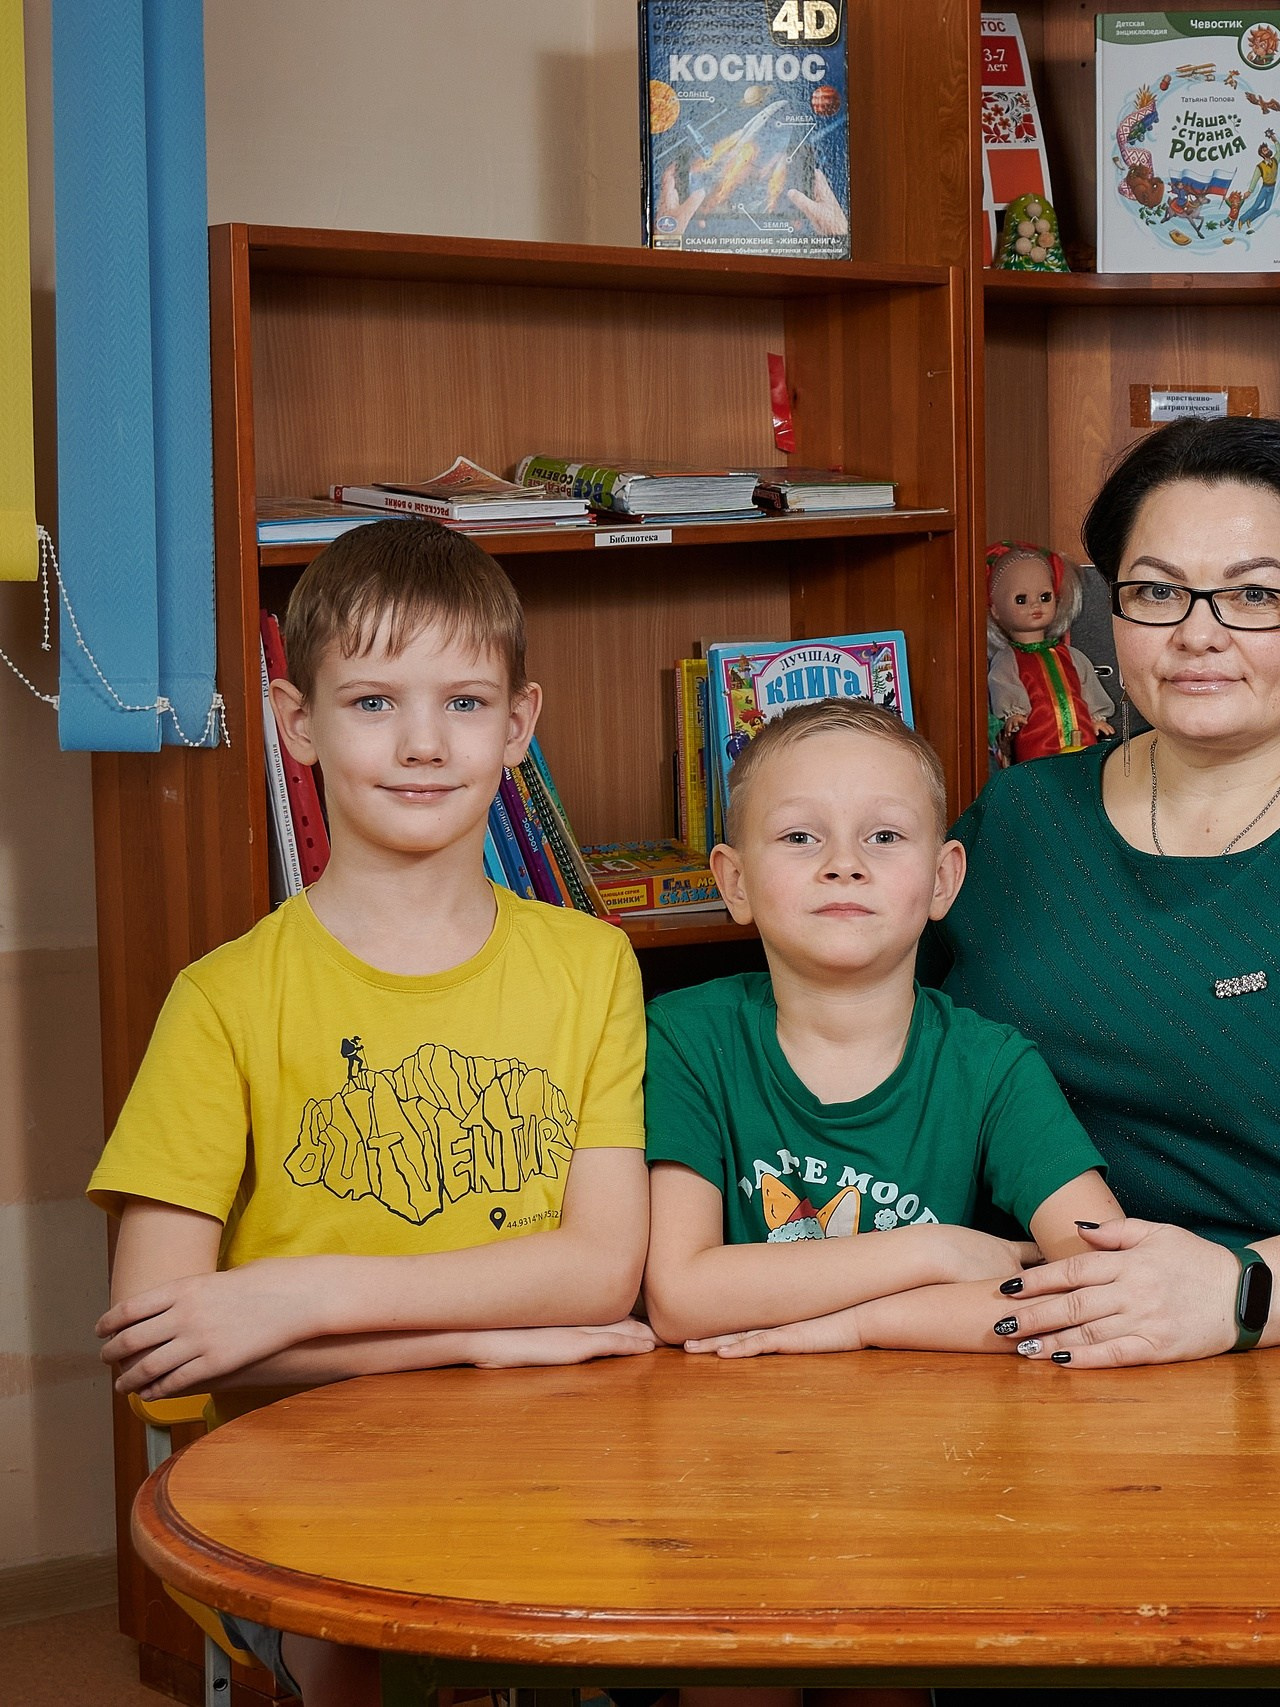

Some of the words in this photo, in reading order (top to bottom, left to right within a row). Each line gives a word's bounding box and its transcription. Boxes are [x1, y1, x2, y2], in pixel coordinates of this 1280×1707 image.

[772, 0, 838, 40] 4D
[1115, 20, 1145, 28] Детская
[1190, 19, 1243, 29] Чевостик
[1115, 28, 1168, 36] энциклопедия
[983, 48, 1005, 61] 3-7
[669, 53, 826, 82] КОСМОС
[987, 63, 1008, 72] лет
[677, 90, 710, 99] СОЛНЦЕ
[1209, 96, 1235, 104] Попова
[785, 115, 814, 123] РАКЕТА
[1183, 110, 1227, 128] Наша
[1178, 127, 1233, 146] страна
[762, 221, 789, 229] ЗЕМЛЯ
[685, 236, 717, 245] СКАЧАЙ
[719, 237, 773, 245] ПРИЛОЖЕНИЕ
[531, 467, 574, 485] СОВЕТЫ
[608, 532, 659, 544] Библиотека
[780, 650, 843, 671] ЛУЧШАЯ
[281, 803, 293, 837] детская
[521, 818, 539, 853] КОСМОС
[659, 887, 720, 905] СКАЗКА
